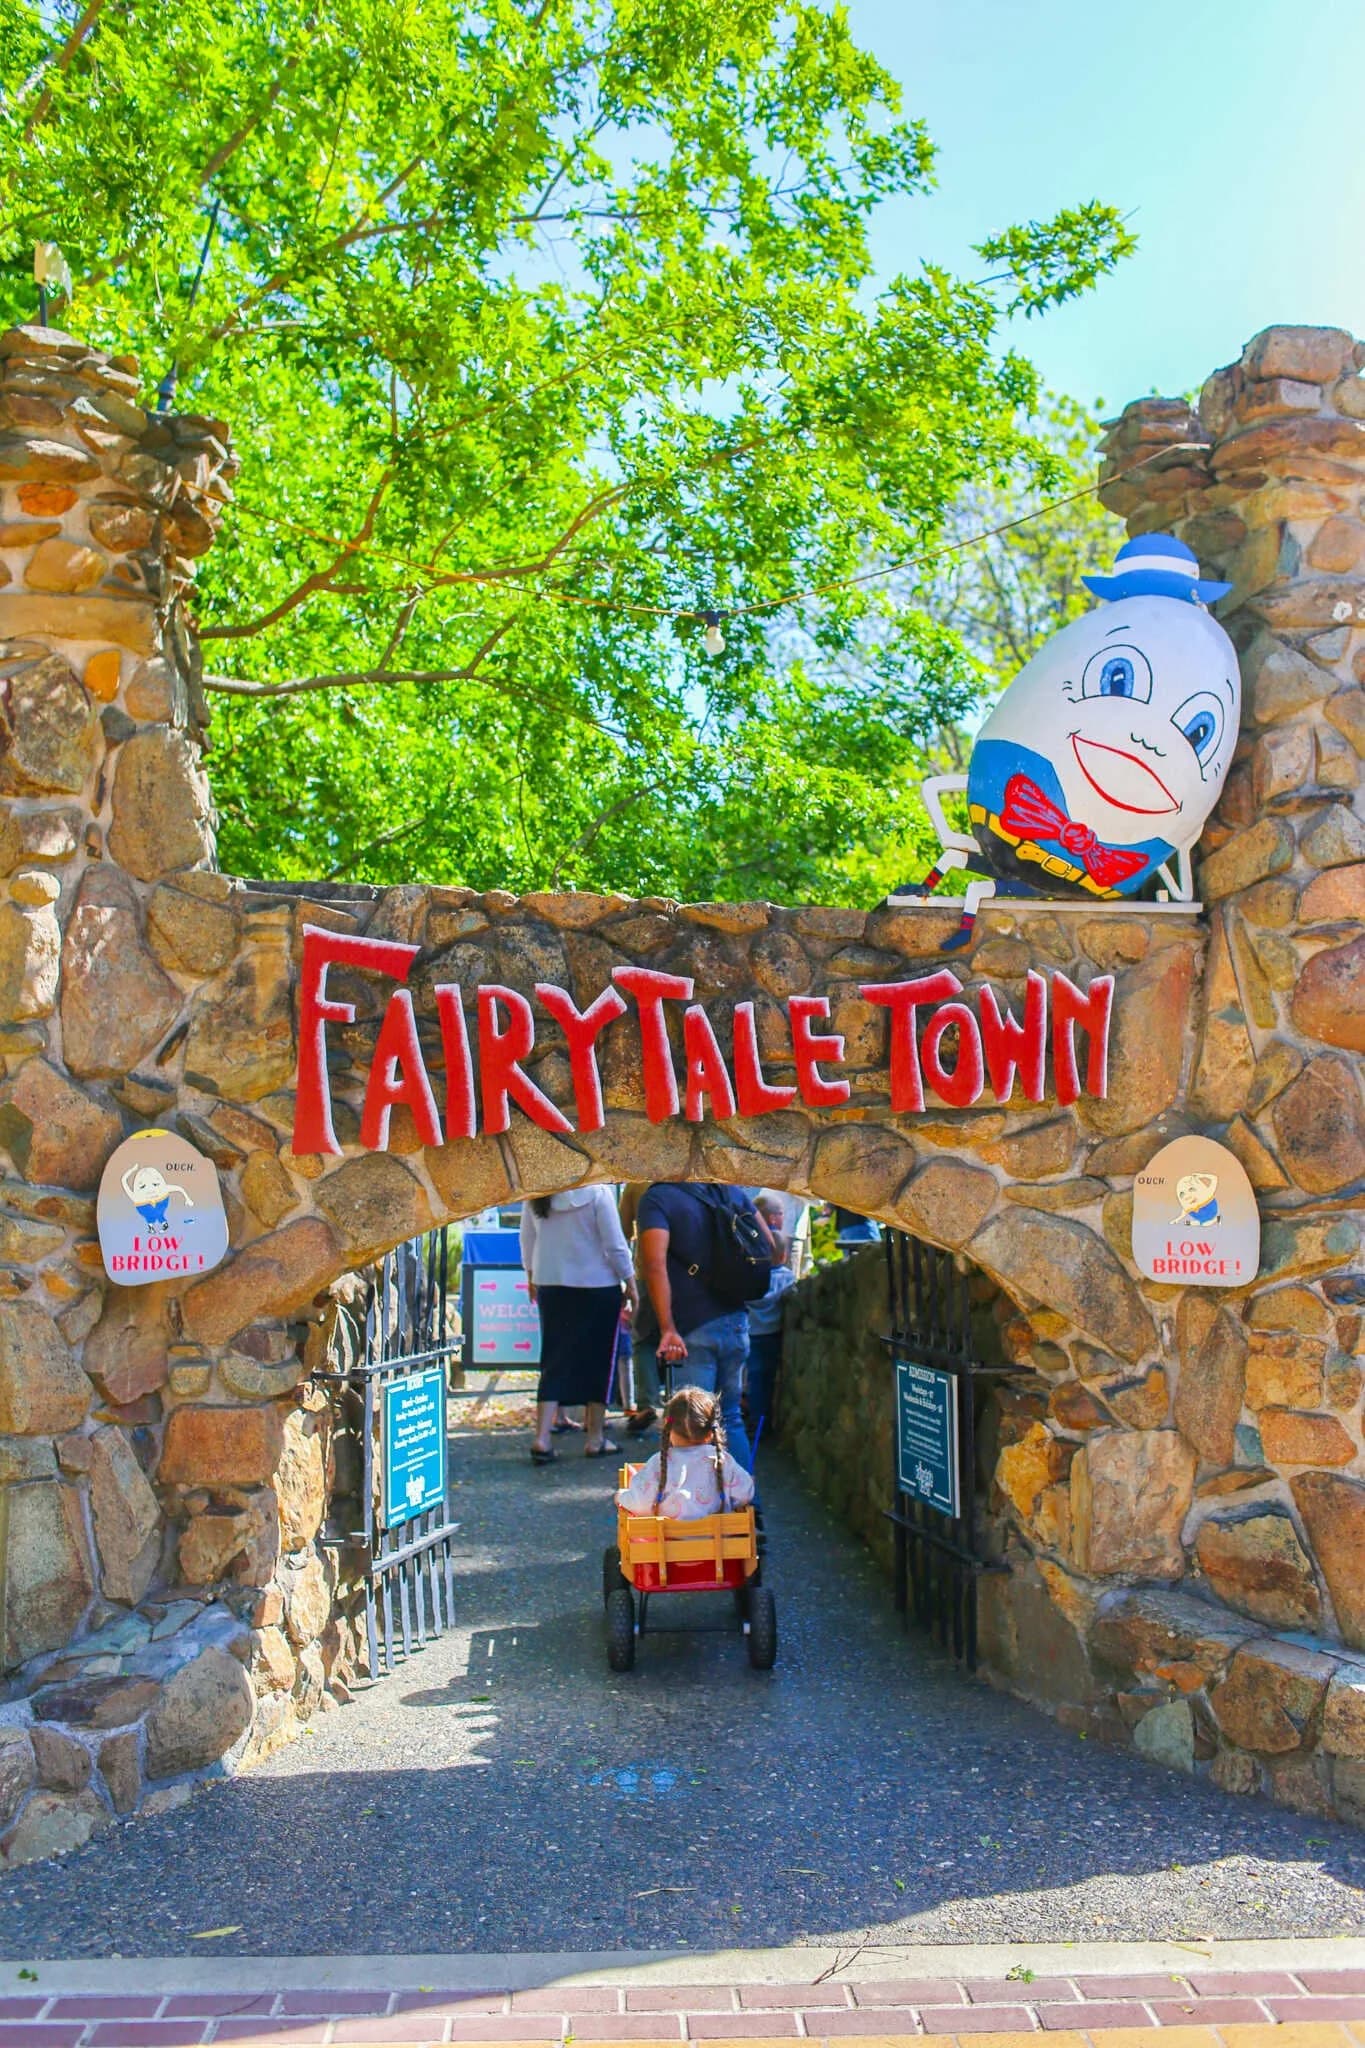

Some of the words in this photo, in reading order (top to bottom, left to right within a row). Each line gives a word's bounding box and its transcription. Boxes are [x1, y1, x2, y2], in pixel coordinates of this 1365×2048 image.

[858, 968, 1116, 1113] TOWN
[133, 1236, 184, 1252] LOW
[1166, 1241, 1216, 1256] LOW
[1153, 1259, 1241, 1275] BRIDGE!
[479, 1304, 539, 1318] WELCO
